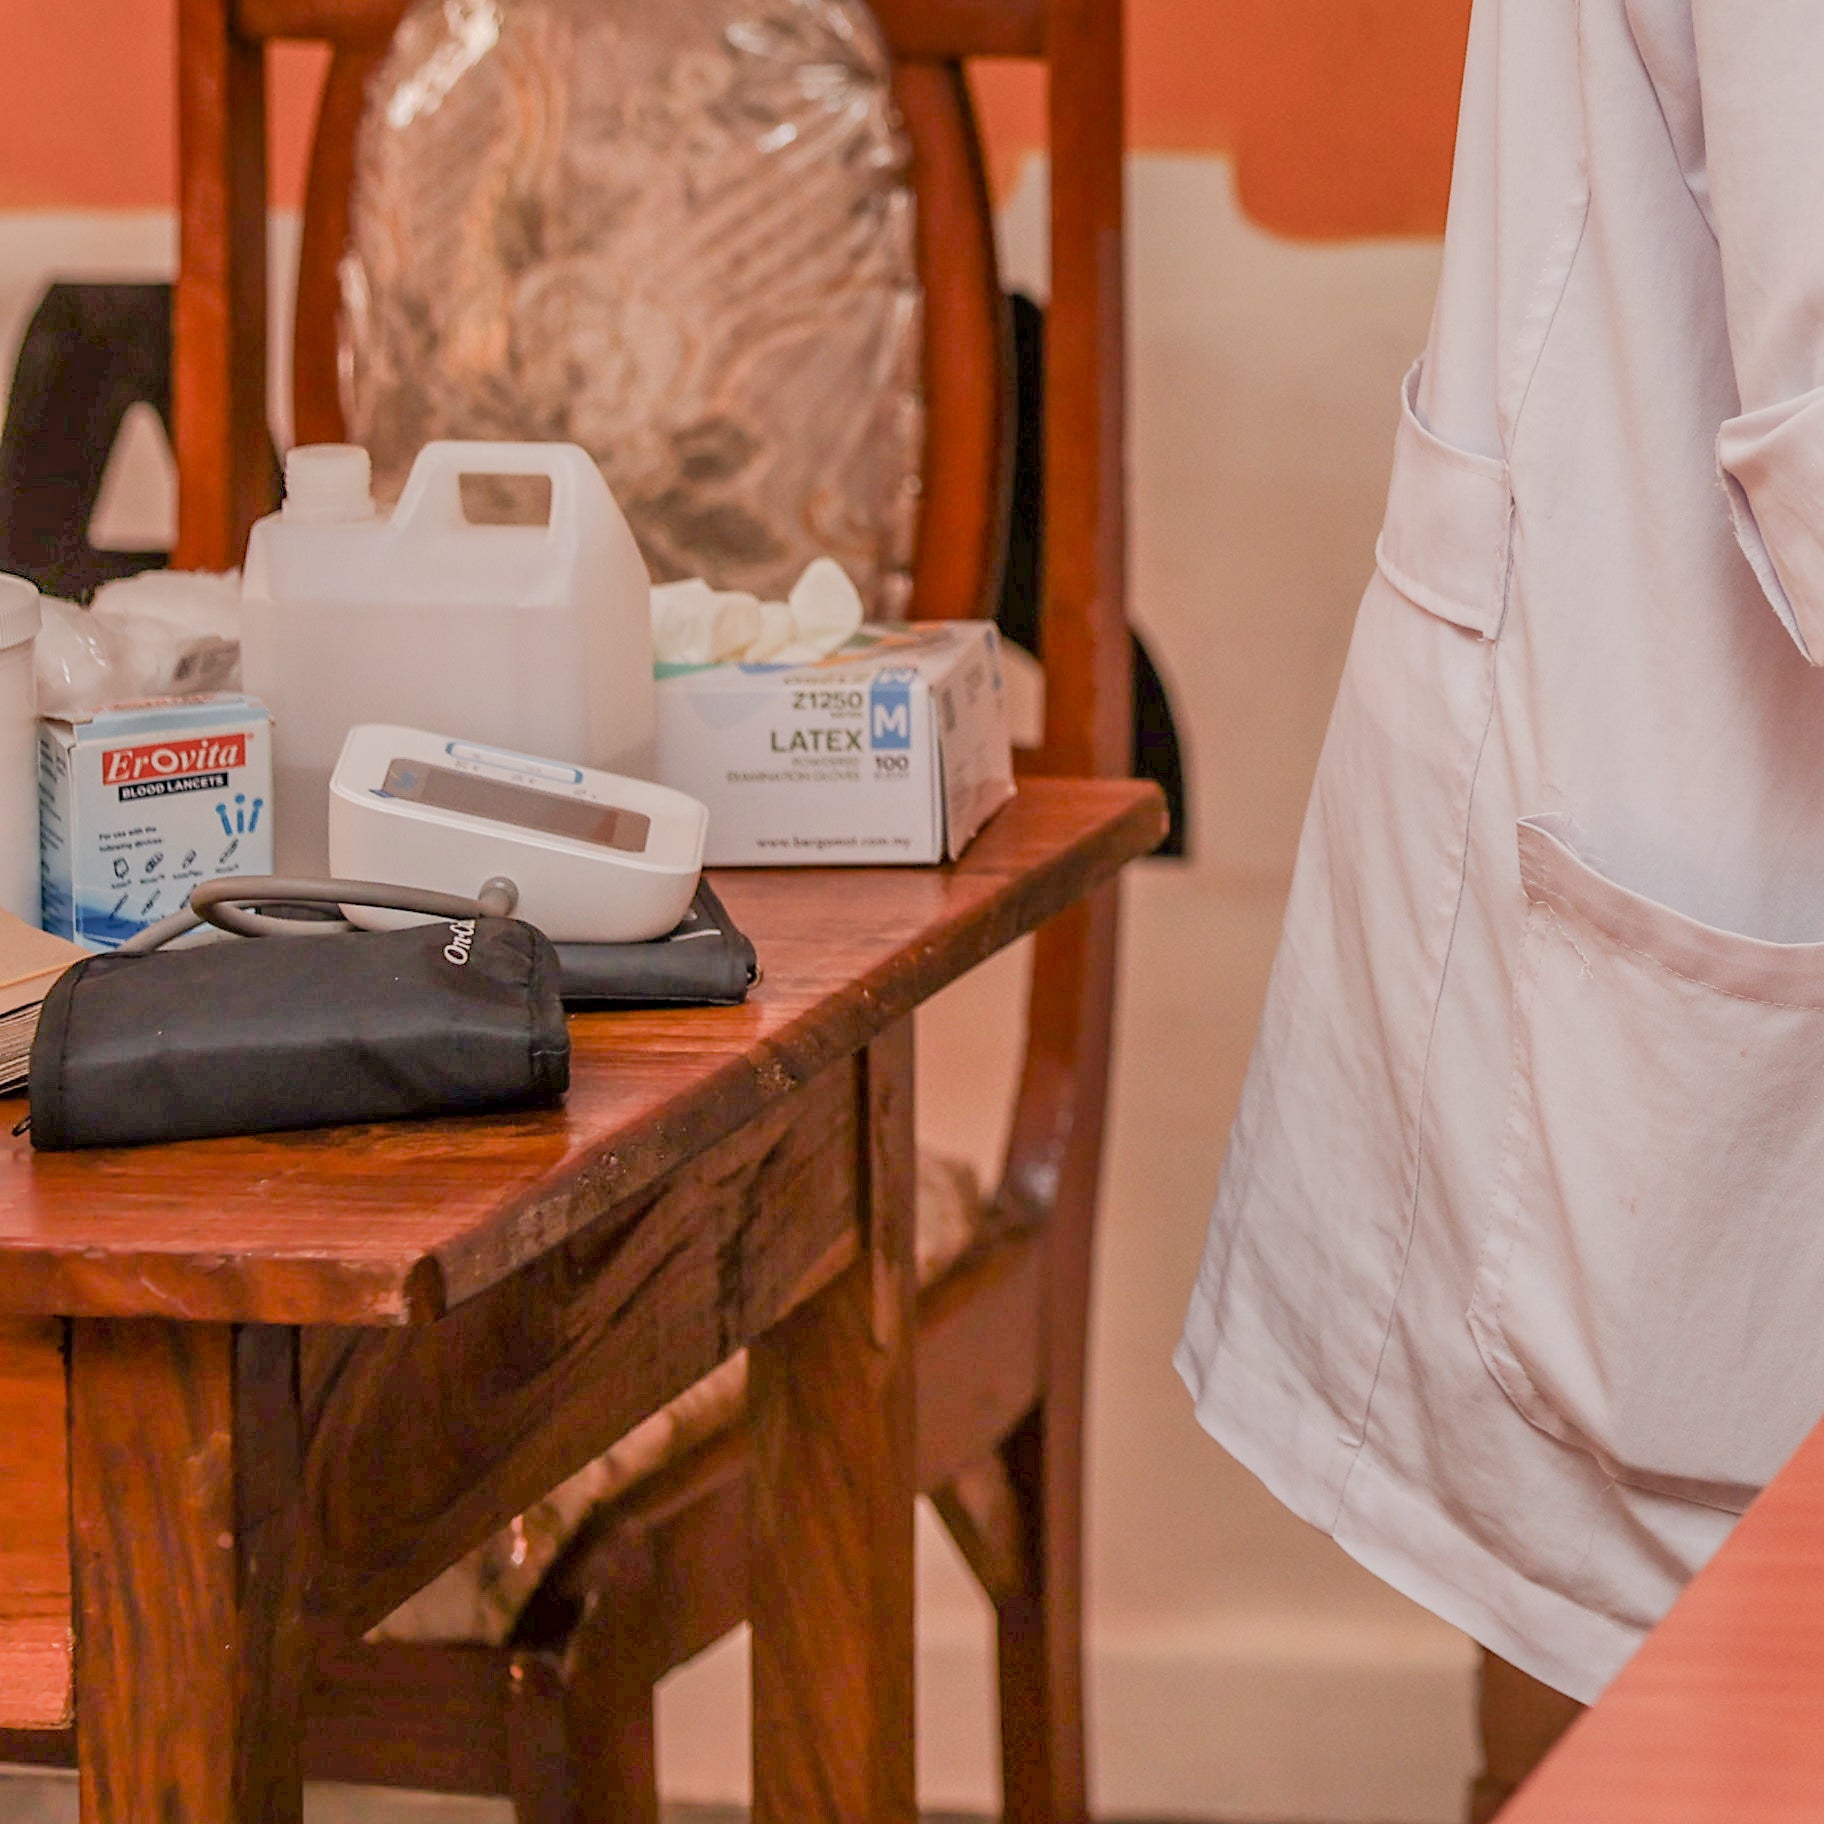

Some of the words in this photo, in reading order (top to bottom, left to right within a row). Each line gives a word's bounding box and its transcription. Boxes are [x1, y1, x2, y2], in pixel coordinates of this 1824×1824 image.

[873, 704, 908, 738] M
[770, 729, 863, 753] LATEX
[875, 756, 909, 771] 100
[121, 782, 164, 800] BLOOD
[167, 775, 225, 793] LANCETS
